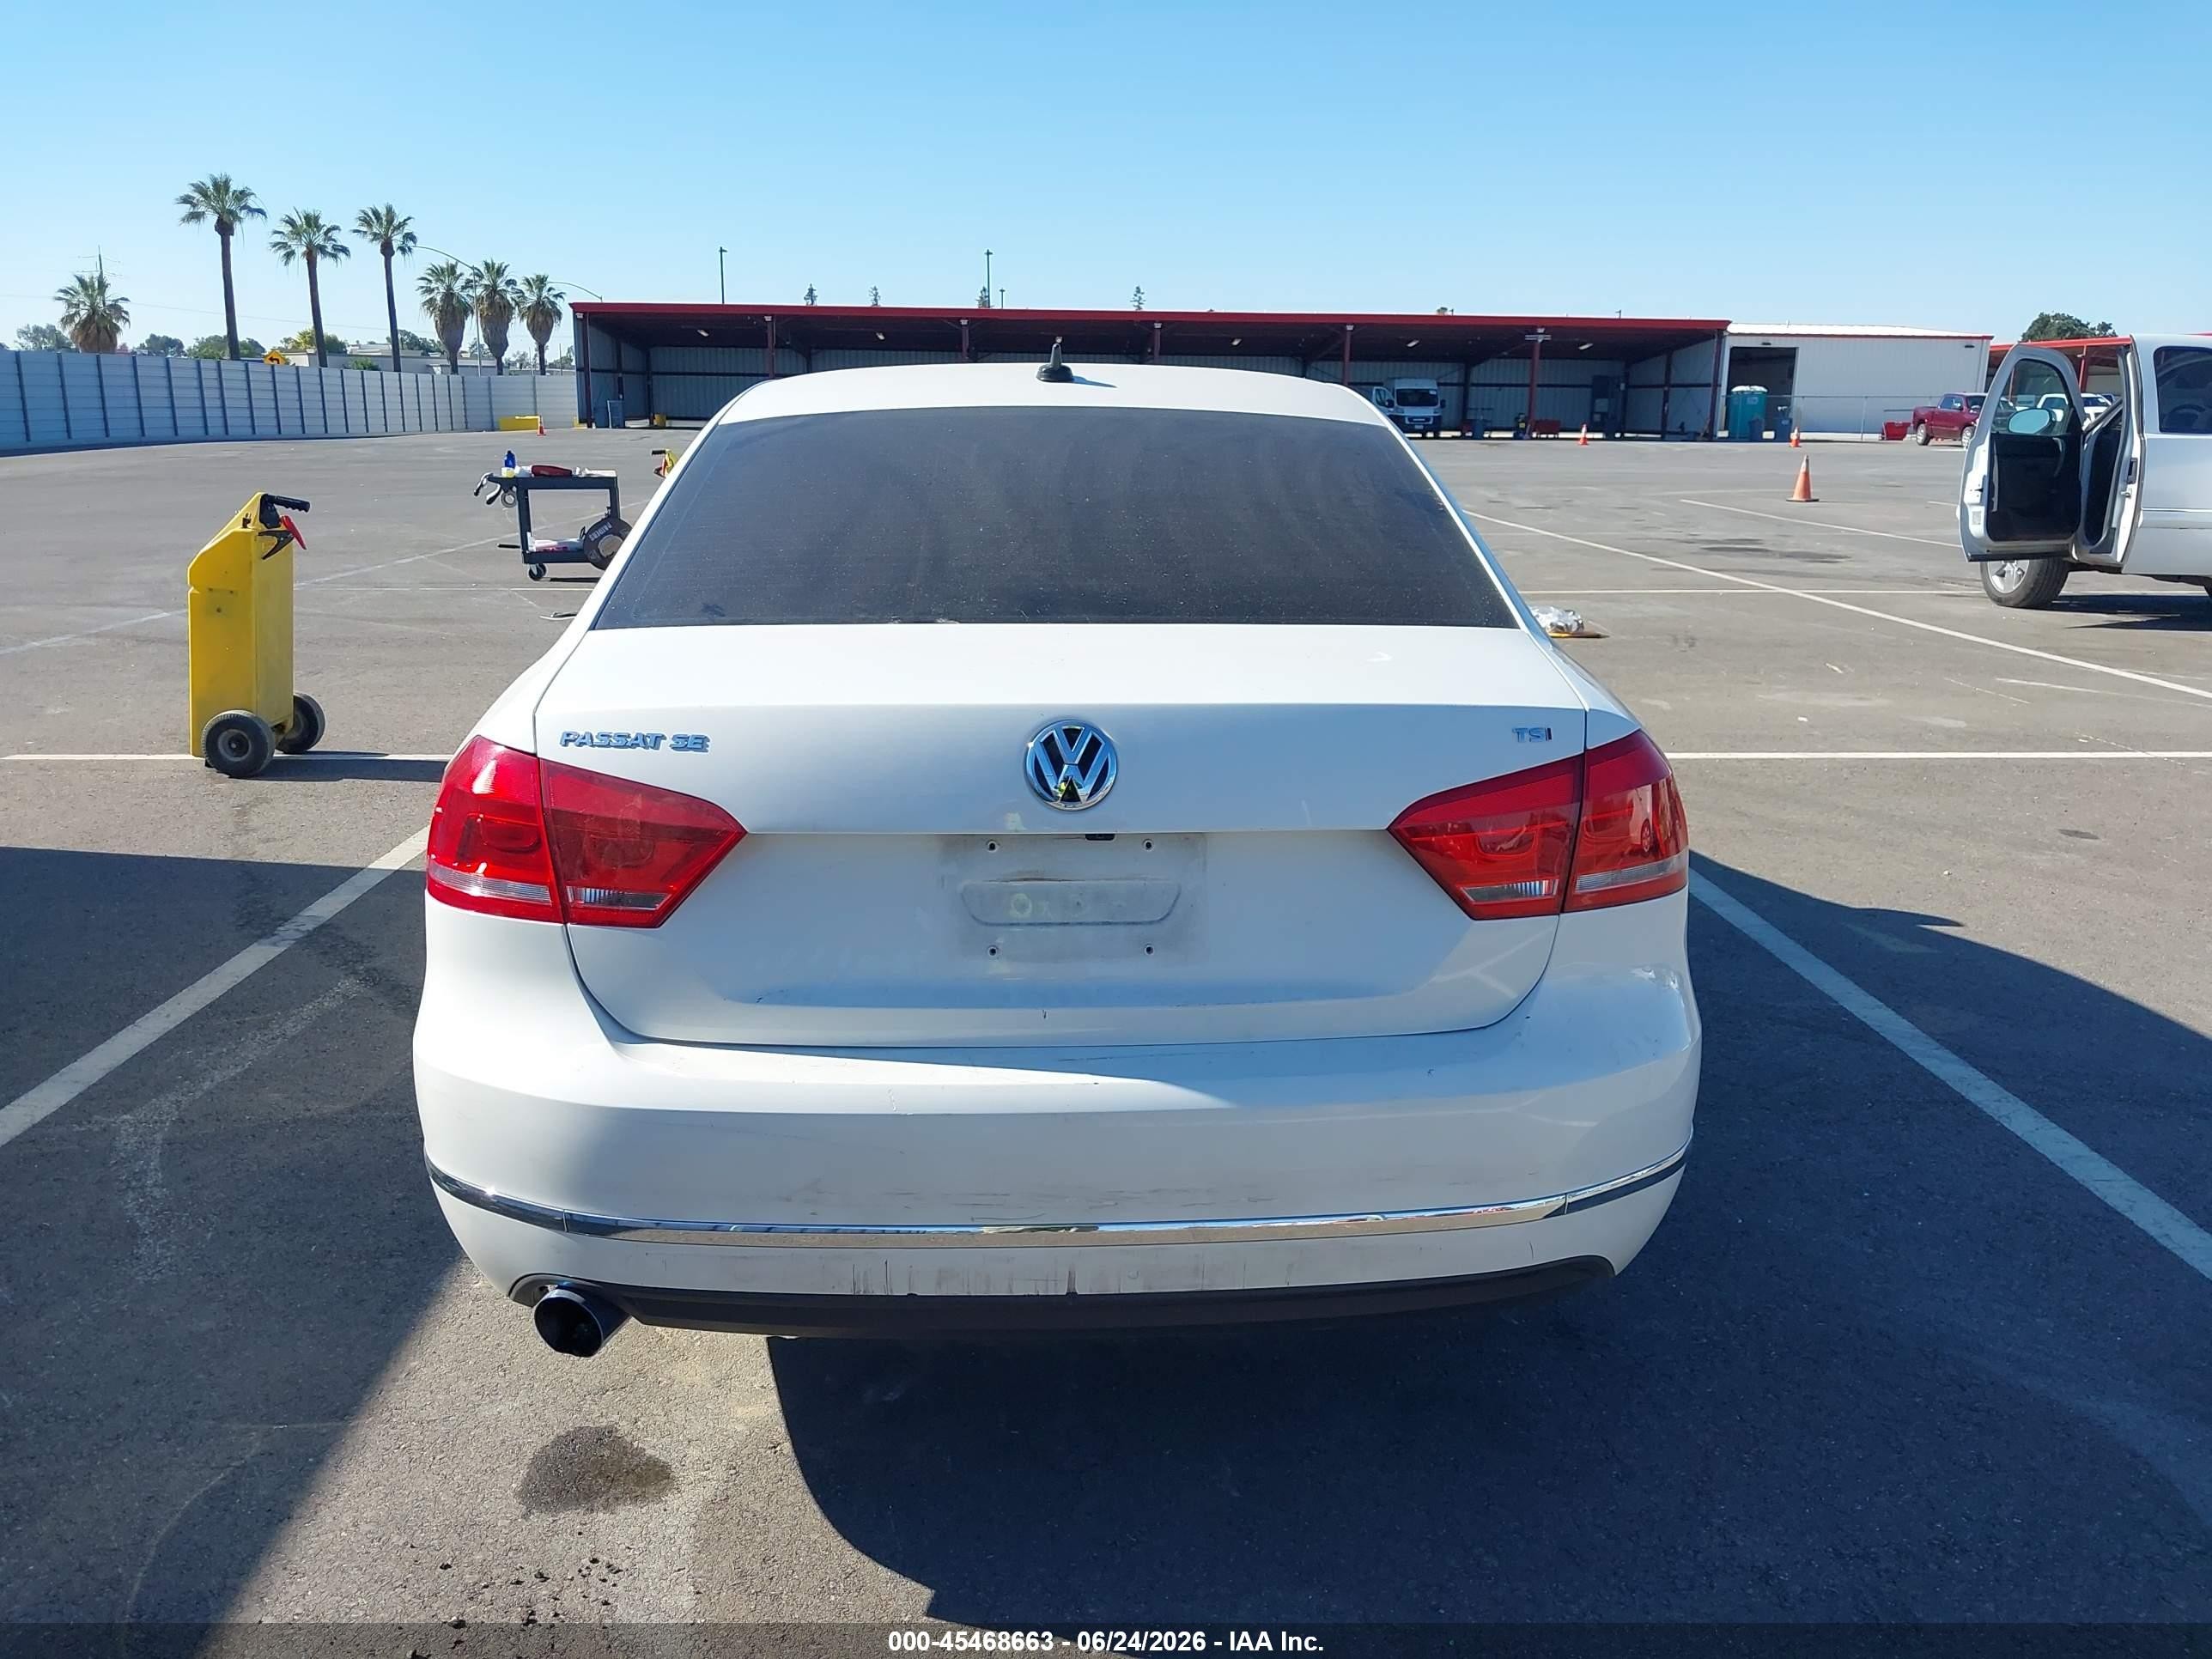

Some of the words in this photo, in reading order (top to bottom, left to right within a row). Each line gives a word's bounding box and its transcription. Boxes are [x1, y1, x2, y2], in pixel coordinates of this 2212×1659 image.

[559, 731, 666, 750] PASSAT
[669, 732, 711, 753] SE
[1512, 727, 1553, 742] TSI
[1027, 720, 1117, 810] VW
